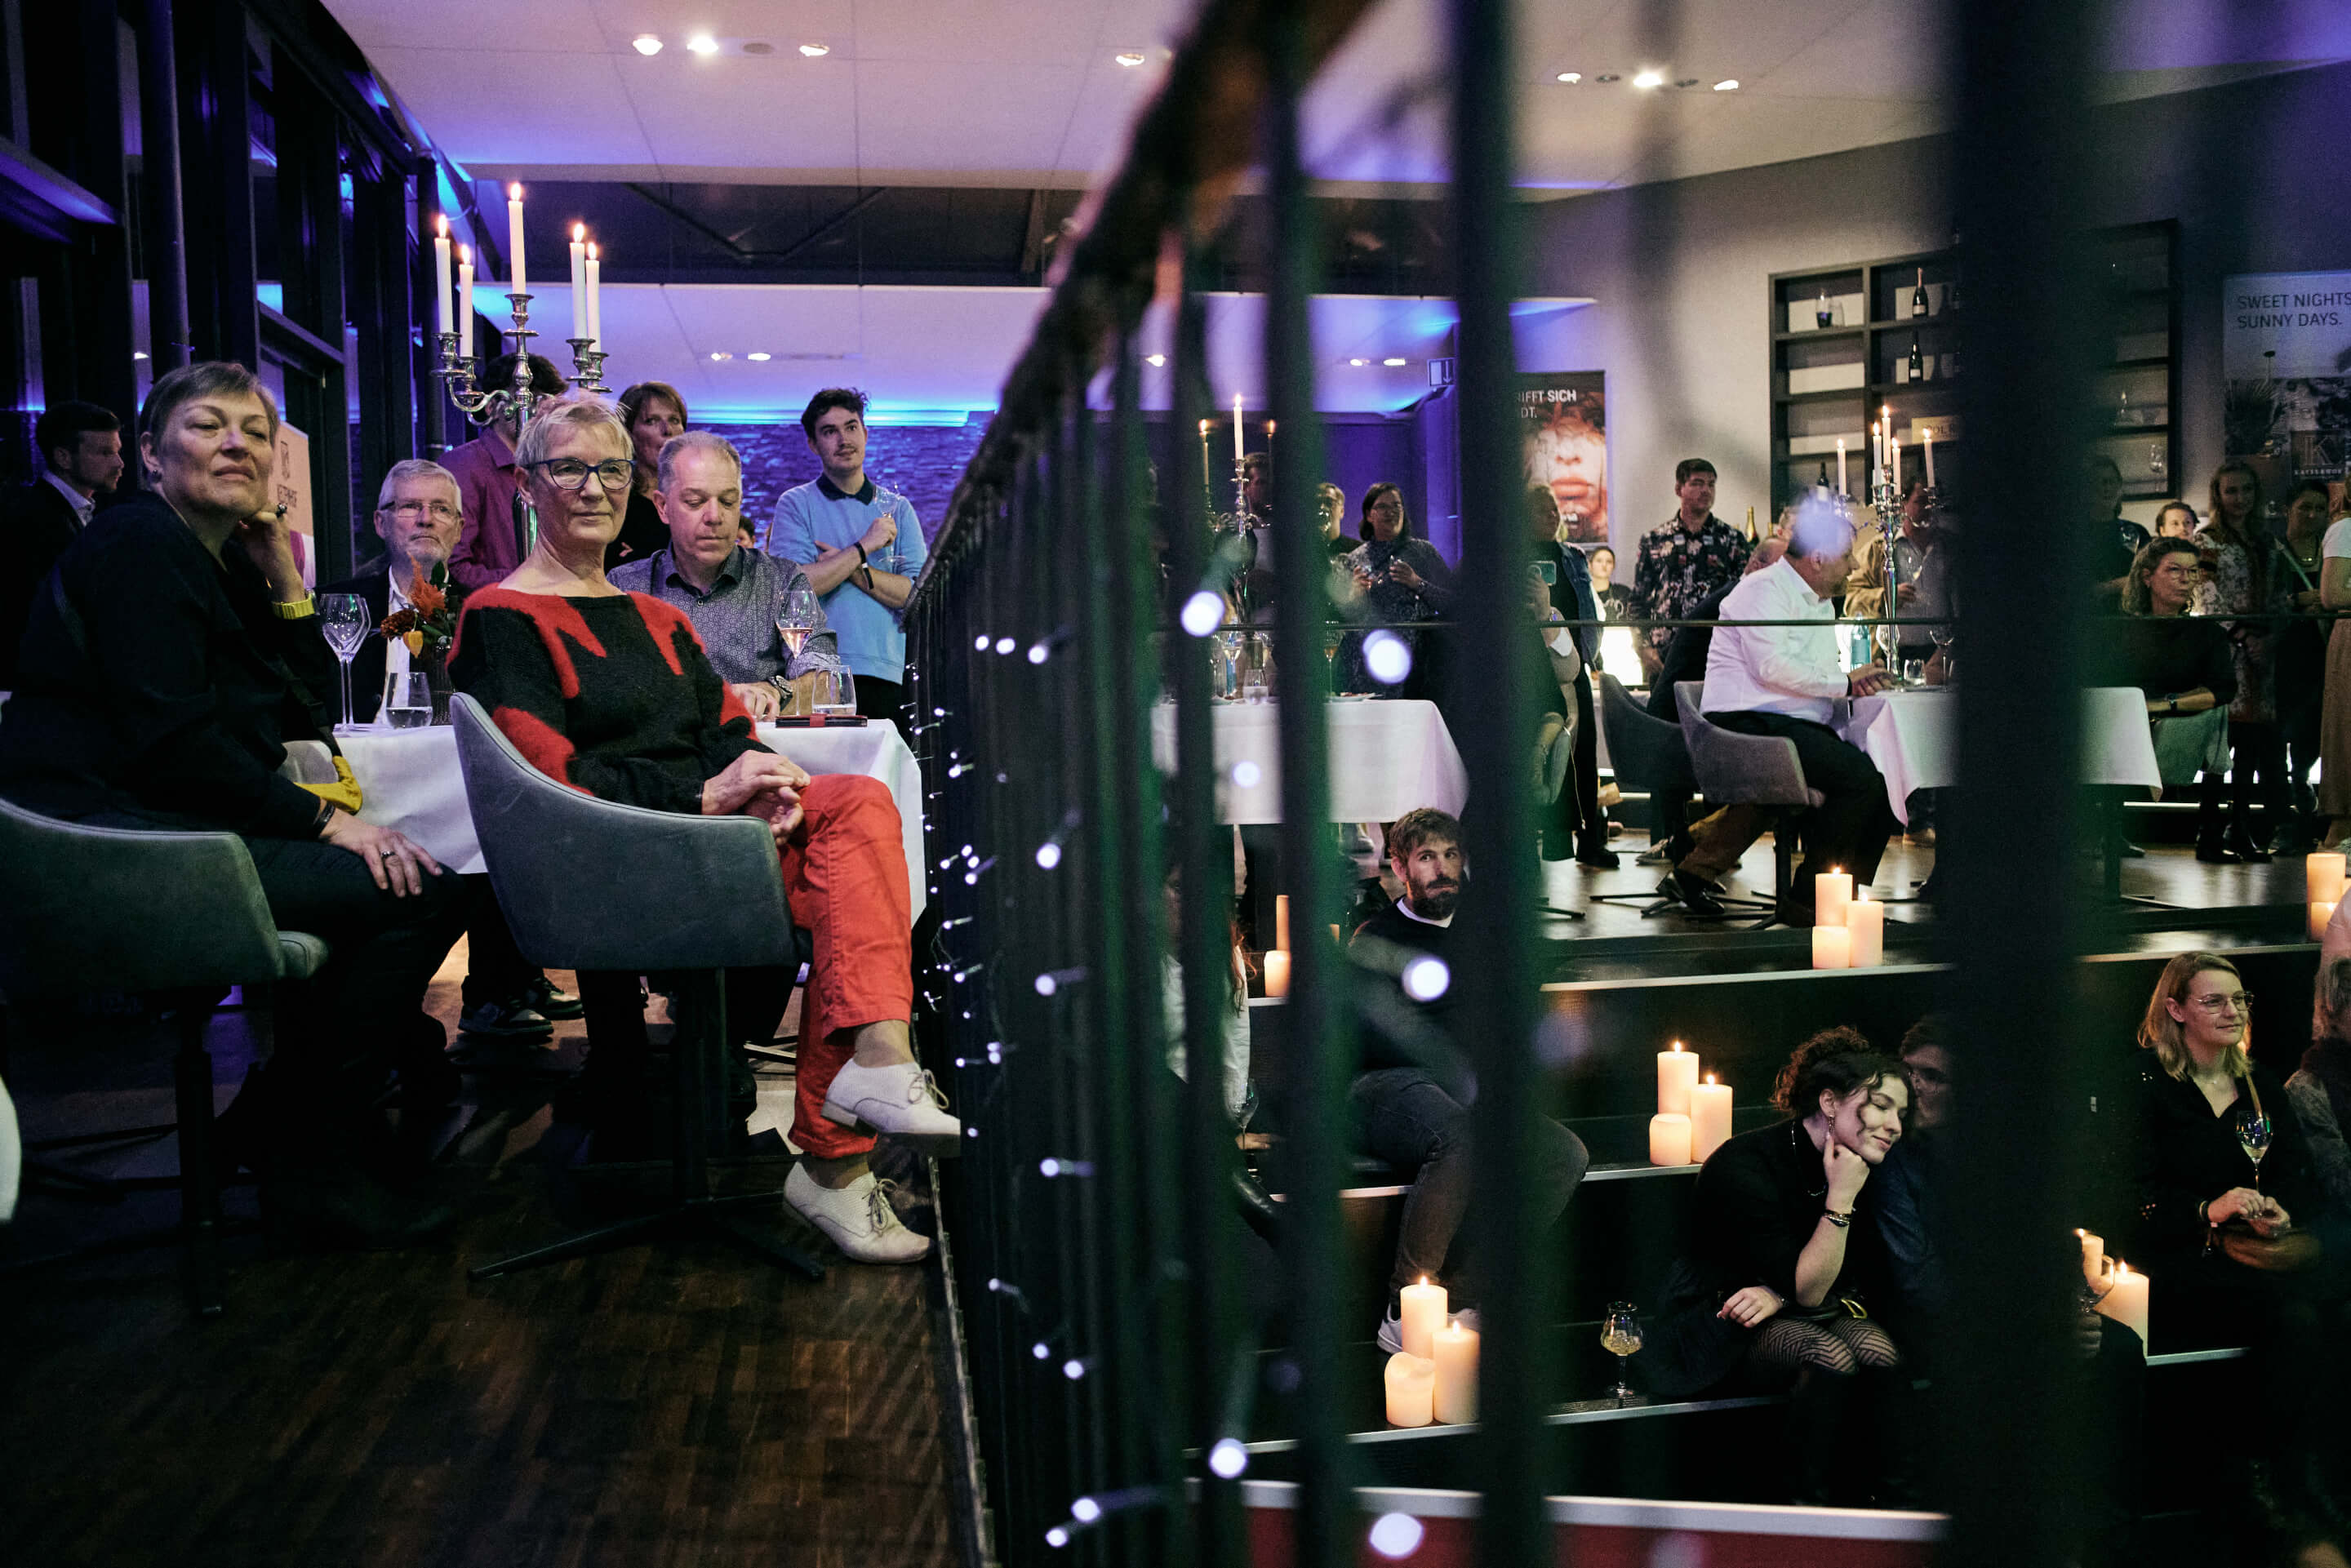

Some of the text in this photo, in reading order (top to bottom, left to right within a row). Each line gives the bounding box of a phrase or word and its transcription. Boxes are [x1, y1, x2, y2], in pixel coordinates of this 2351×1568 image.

[2238, 292, 2351, 309] SWEET NIGHTS
[2237, 312, 2343, 329] SUNNY DAYS.
[1547, 388, 1577, 403] SICH
[1521, 406, 1538, 419] DT.
